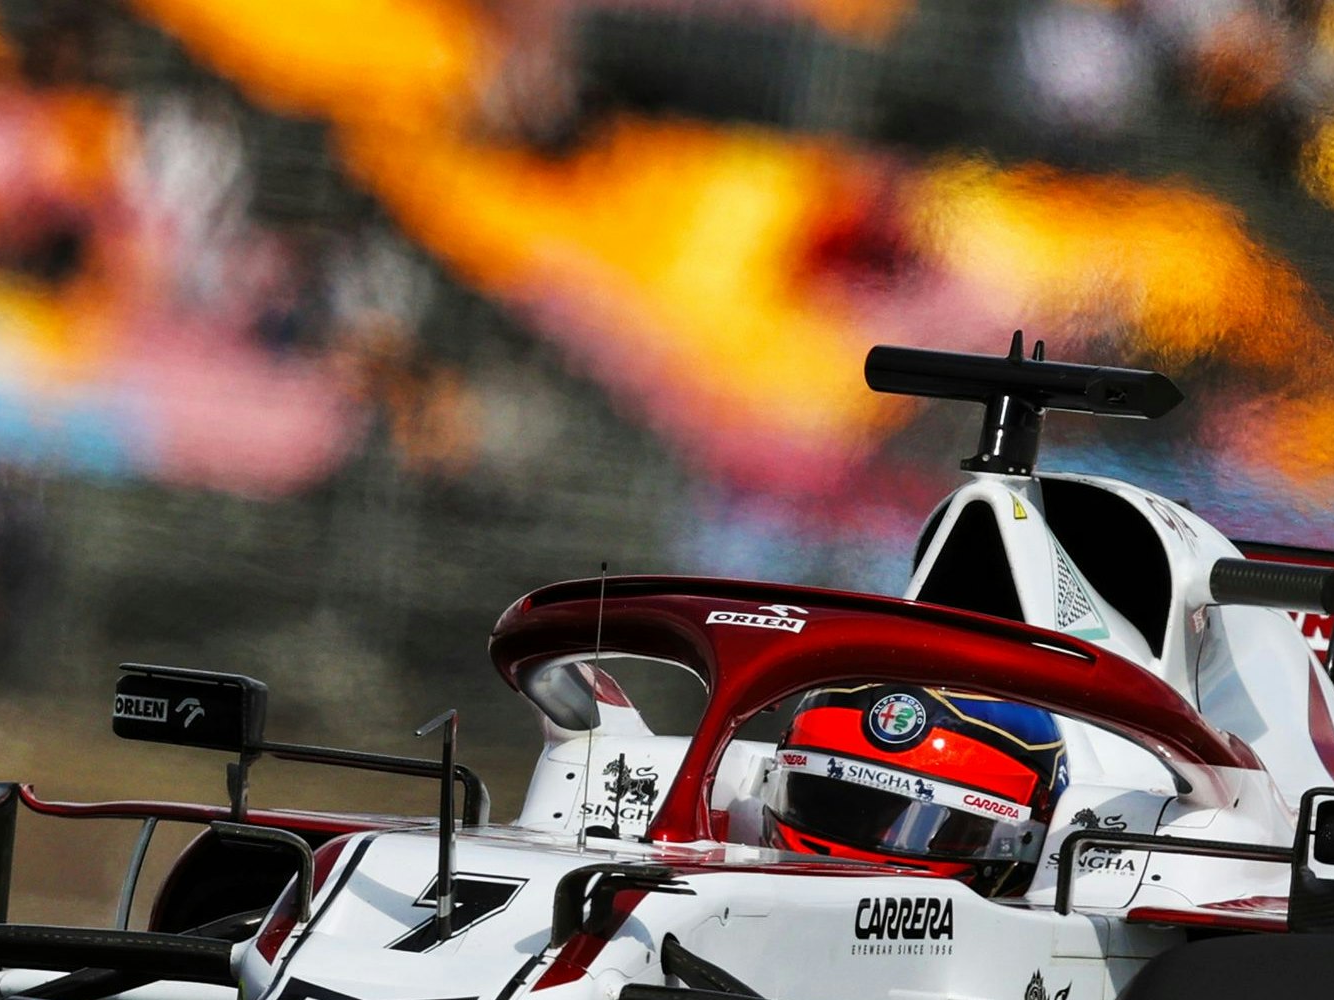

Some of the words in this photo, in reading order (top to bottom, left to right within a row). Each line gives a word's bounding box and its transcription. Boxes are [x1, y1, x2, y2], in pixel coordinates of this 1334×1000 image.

[713, 613, 798, 629] ORLEN
[115, 697, 165, 718] ORLEN
[847, 765, 910, 791] SINGHA
[579, 803, 653, 821] SINGH
[963, 794, 1019, 819] CARRERA
[1047, 853, 1136, 872] SNGHA
[383, 871, 530, 954] 7
[854, 897, 954, 940] CARRERA
[851, 944, 893, 956] EYEWEAR
[897, 944, 924, 956] SINCE
